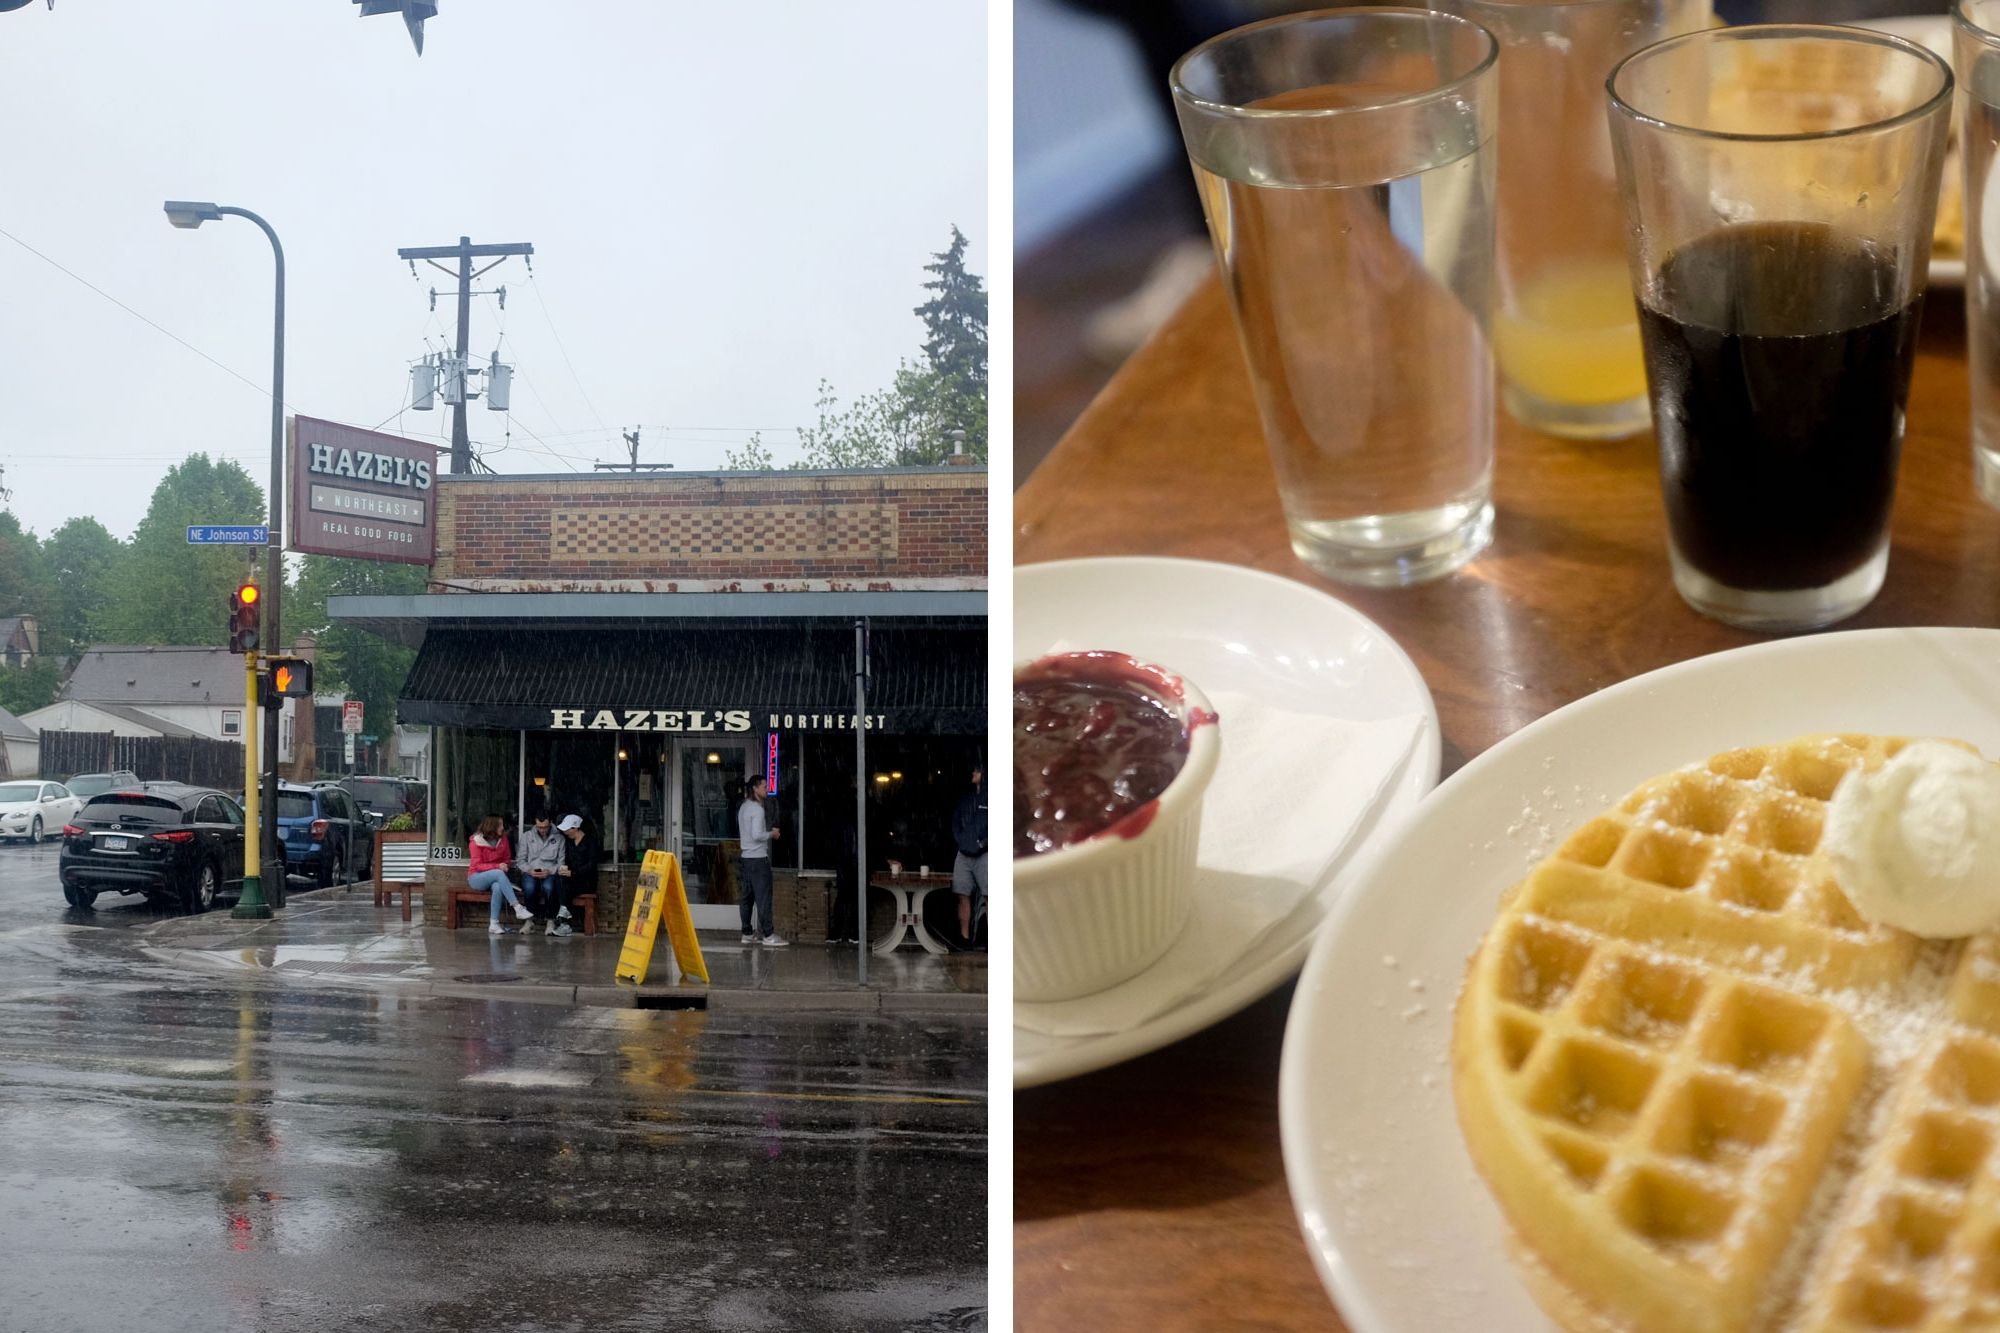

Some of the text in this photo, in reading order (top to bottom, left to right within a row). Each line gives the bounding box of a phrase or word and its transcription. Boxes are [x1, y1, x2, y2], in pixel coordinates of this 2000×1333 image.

[309, 443, 432, 490] HAZEL'S
[334, 494, 408, 516] NORTHEAST
[191, 529, 264, 541] NE Johnson St
[322, 521, 413, 544] REAL GOOD FOOD
[550, 709, 886, 732] HAZEL'S NORTHEAST
[769, 734, 777, 793] OPEN
[434, 847, 460, 859] 2859
